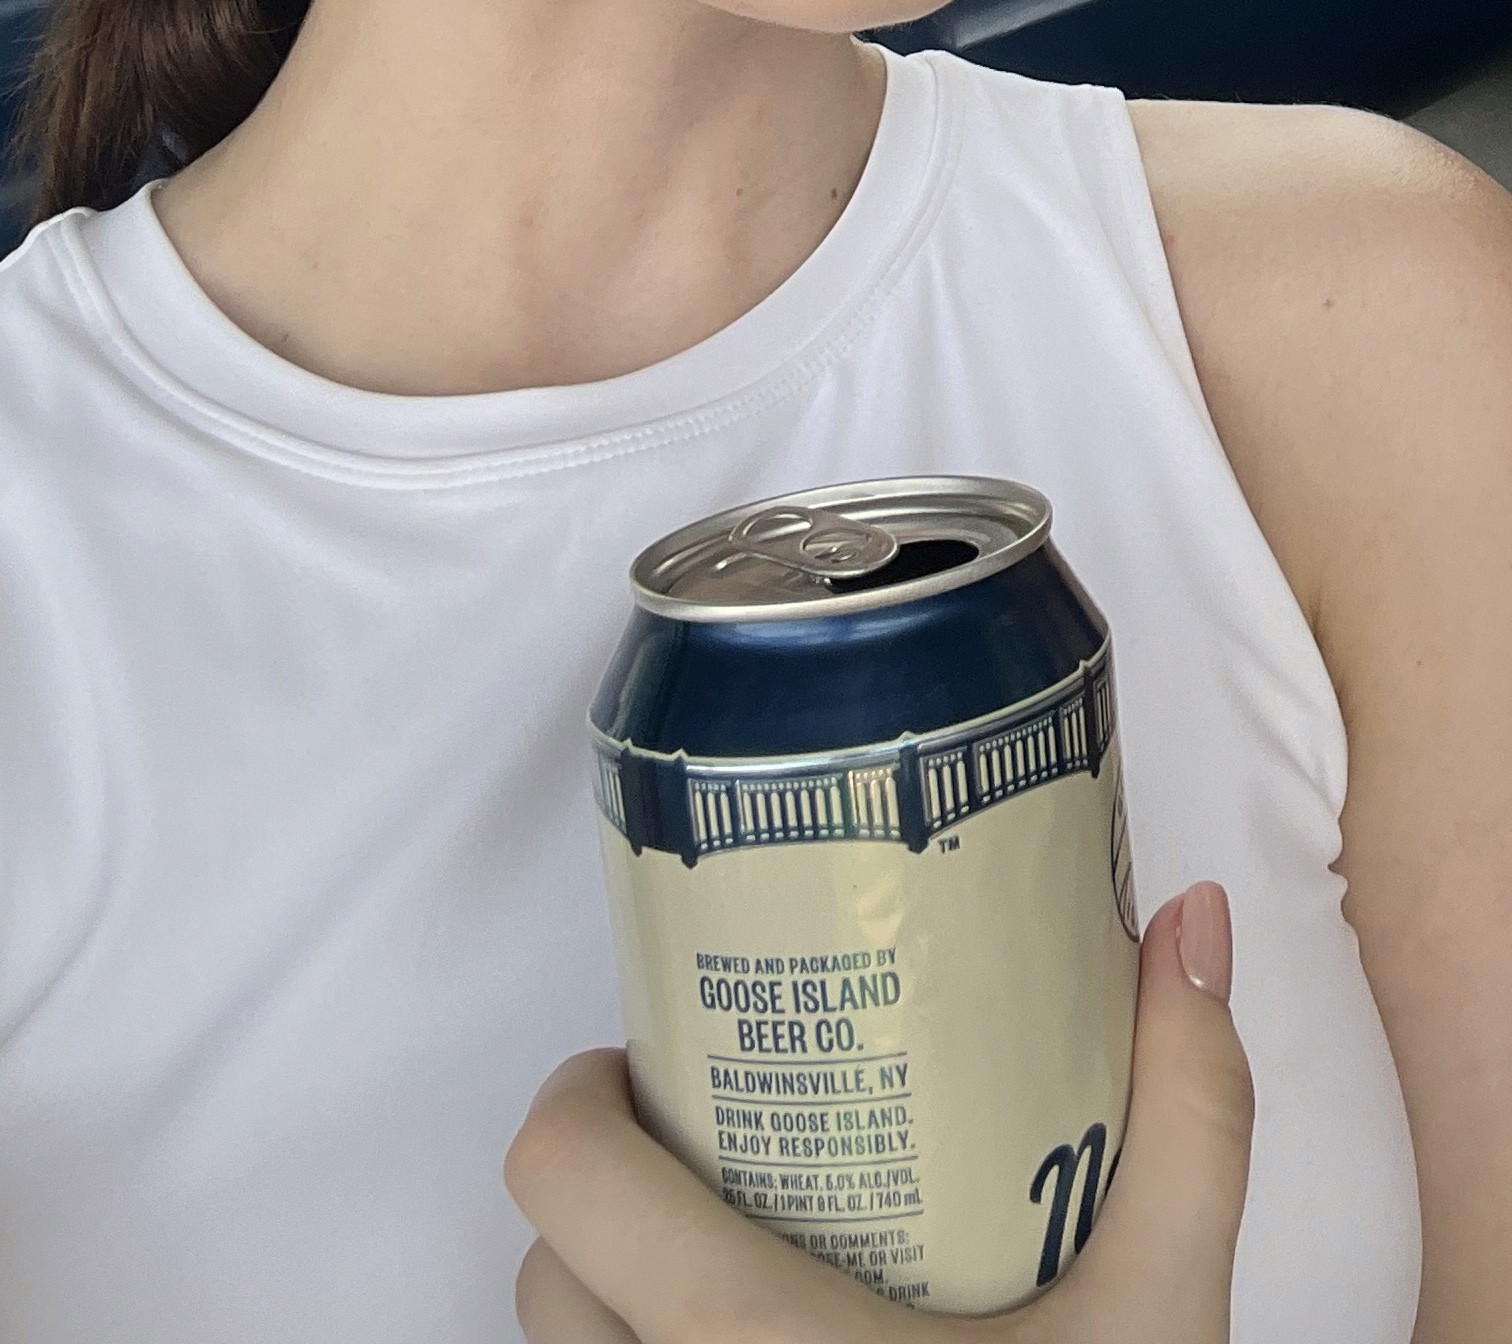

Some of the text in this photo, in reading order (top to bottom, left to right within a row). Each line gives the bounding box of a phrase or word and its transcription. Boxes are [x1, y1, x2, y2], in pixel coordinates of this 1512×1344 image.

[696, 946, 896, 975] BREWED AND PACKAGED BY
[700, 971, 901, 1014] GOOSE ISLAND
[737, 1017, 865, 1053] BEER CO.
[710, 1062, 908, 1096] BALDWINSVILLE, NY
[714, 1105, 915, 1133] DRINK GOOSE ISLAND.
[718, 1130, 916, 1158] ENJOY RESPONSIBLY.
[890, 1244, 925, 1265] VISIT
